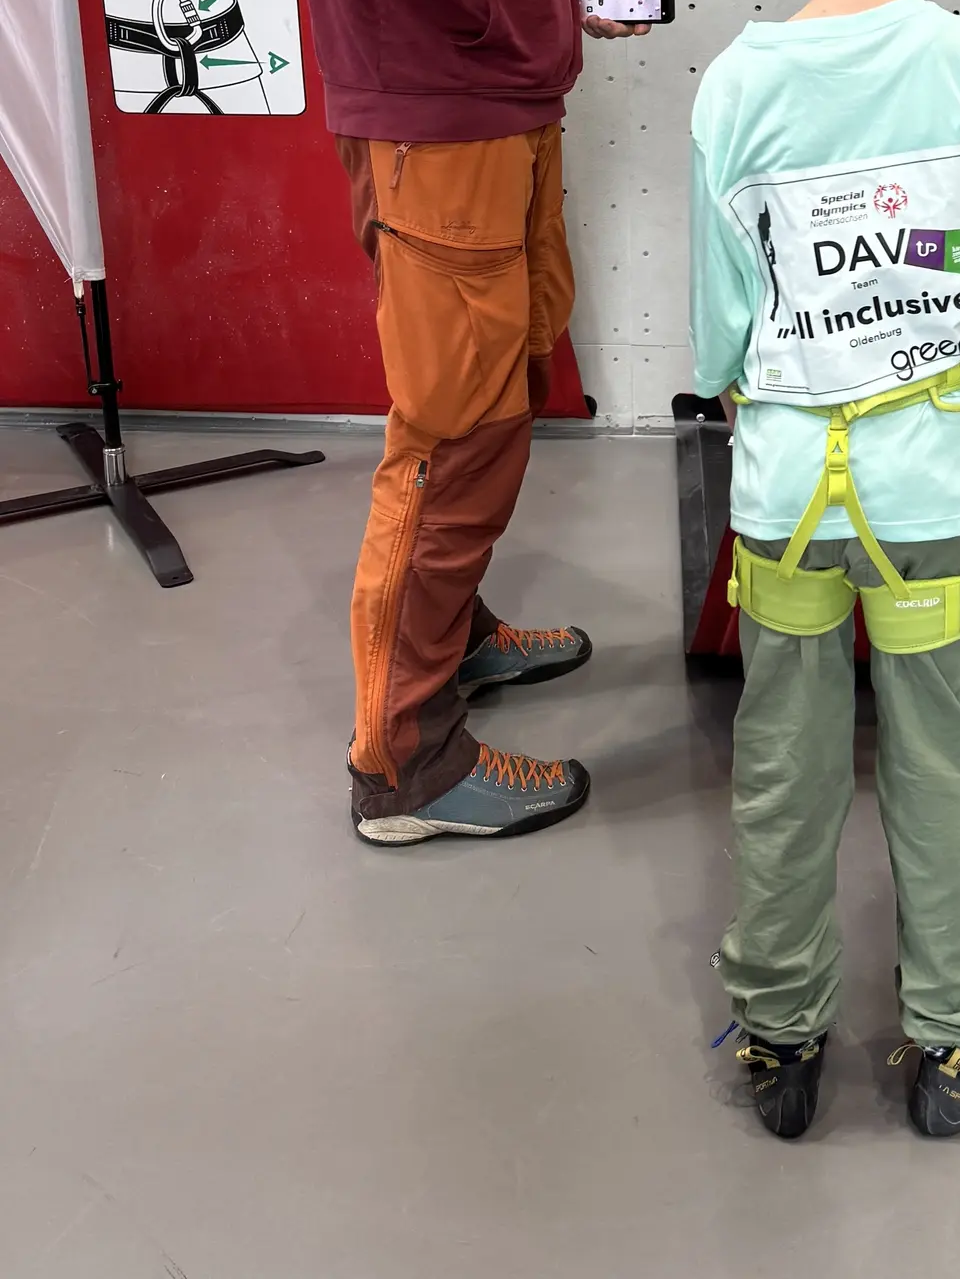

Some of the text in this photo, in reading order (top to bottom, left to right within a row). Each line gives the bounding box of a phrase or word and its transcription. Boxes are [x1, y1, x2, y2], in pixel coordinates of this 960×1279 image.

[820, 190, 865, 204] Special
[811, 202, 867, 218] Olympics
[810, 213, 868, 228] Niedersachsen
[813, 228, 906, 277] DAV
[851, 277, 879, 290] Team
[850, 326, 903, 348] Oldenburg
[895, 597, 941, 608] EDELRID
[525, 800, 556, 811] SCARPA
